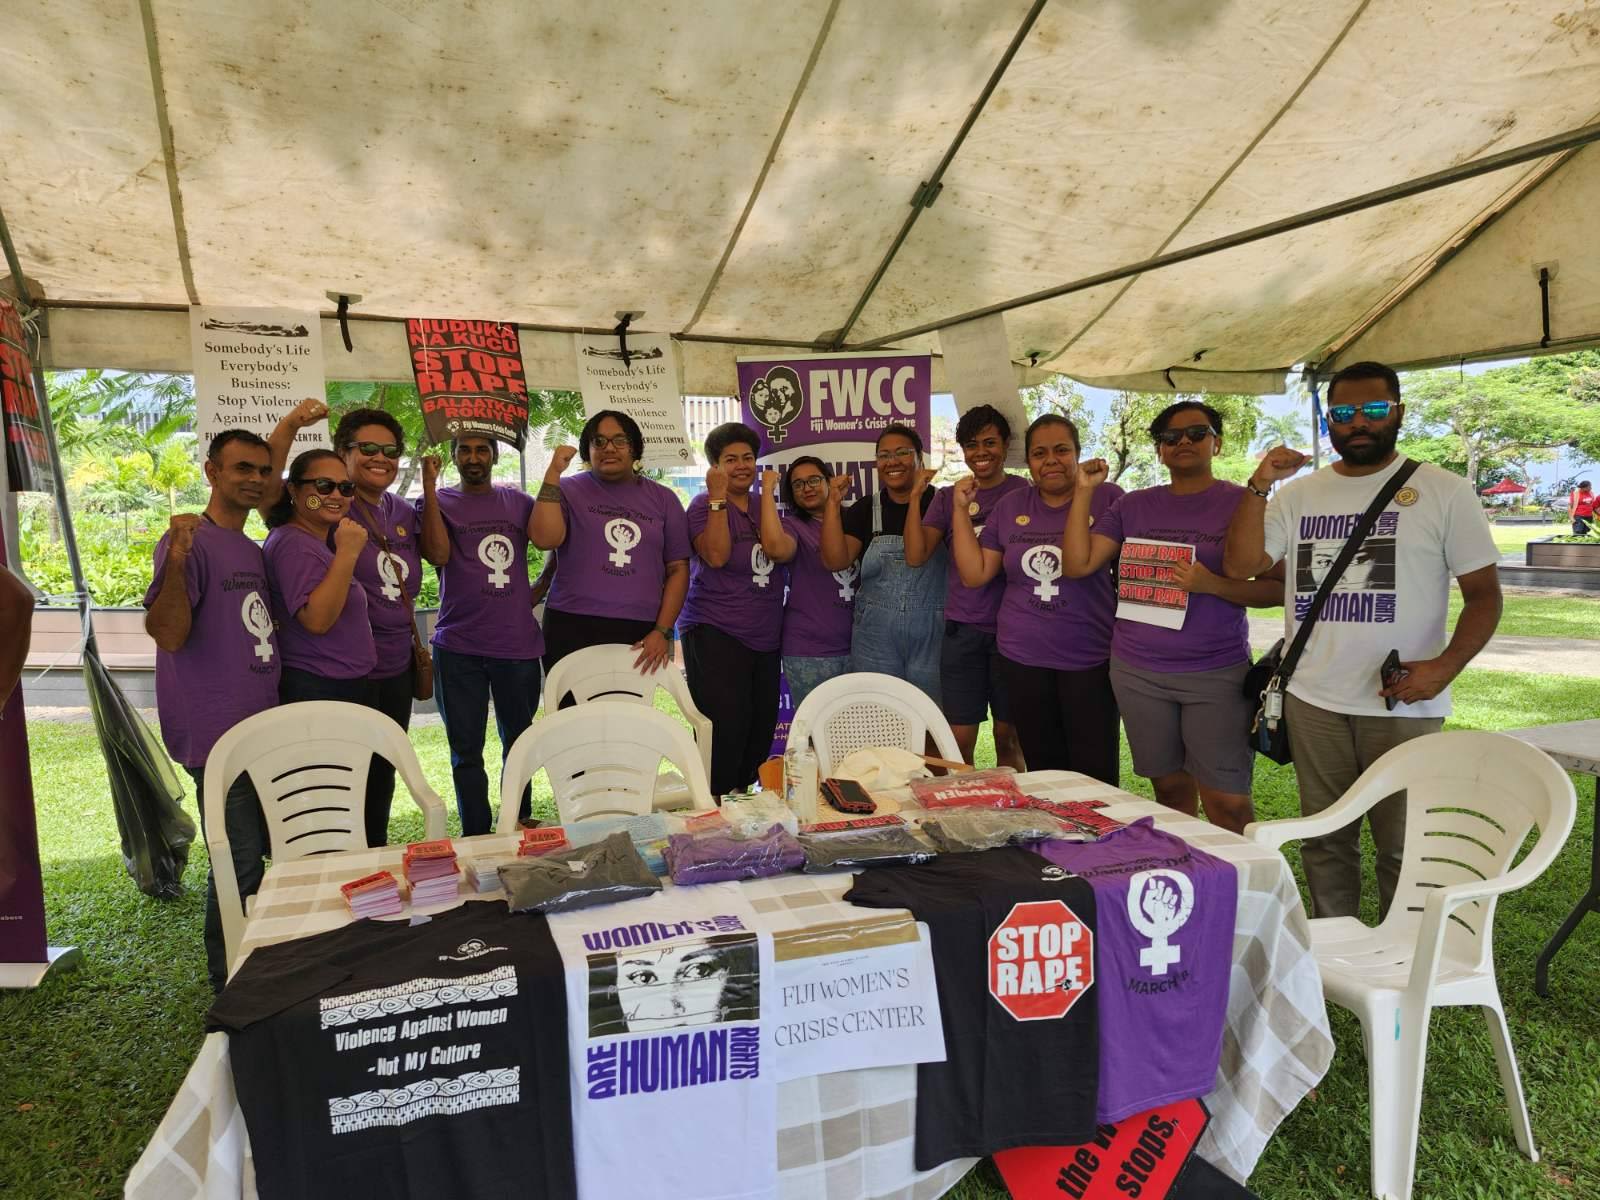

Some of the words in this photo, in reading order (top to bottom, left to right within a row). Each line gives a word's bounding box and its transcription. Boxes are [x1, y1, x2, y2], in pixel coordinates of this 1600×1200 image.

[204, 342, 282, 357] Somebody's
[286, 344, 311, 356] Life
[409, 333, 446, 346] NA
[453, 332, 519, 353] KUCU
[220, 359, 298, 375] Everybody's
[413, 349, 522, 377] STOP
[586, 365, 644, 379] Somebody's
[646, 364, 666, 375] Life
[231, 377, 291, 390] Business:
[416, 370, 528, 402] RAPE
[599, 380, 658, 392] Everybody's
[808, 366, 916, 418] FWCC
[217, 394, 247, 409] Stop
[423, 397, 528, 420] BALAATKAR
[609, 395, 655, 404] Business:
[212, 412, 262, 426] Against
[627, 408, 668, 418] Violence
[810, 418, 823, 433] Fiji
[825, 417, 863, 431] Women's
[865, 416, 888, 429] Crisis
[640, 421, 675, 431] Women
[1122, 543, 1157, 559] STOP
[1158, 546, 1192, 563] RAPE
[1120, 563, 1155, 580] STOP
[1156, 566, 1176, 582] RA
[1119, 583, 1154, 600] STOP
[1154, 587, 1187, 606] RAPE
[1374, 593, 1397, 623] RIGHTS
[997, 920, 1082, 962] STOP
[782, 984, 816, 1008] FIJI
[819, 967, 911, 999] WOMEN'S
[997, 956, 1084, 997] RAPE
[1127, 975, 1178, 995] MARCH
[335, 1023, 396, 1052] Violence
[400, 1012, 452, 1040] Against
[456, 1007, 508, 1029] Women
[774, 1014, 839, 1048] CRISIS
[842, 1004, 926, 1034] CENTER
[404, 1051, 427, 1071] My
[430, 1043, 482, 1066] Culture
[618, 1028, 728, 1097] HUMAN
[729, 1026, 760, 1080] RIGHTS
[587, 1042, 618, 1101] ARE
[1056, 1147, 1100, 1200] the
